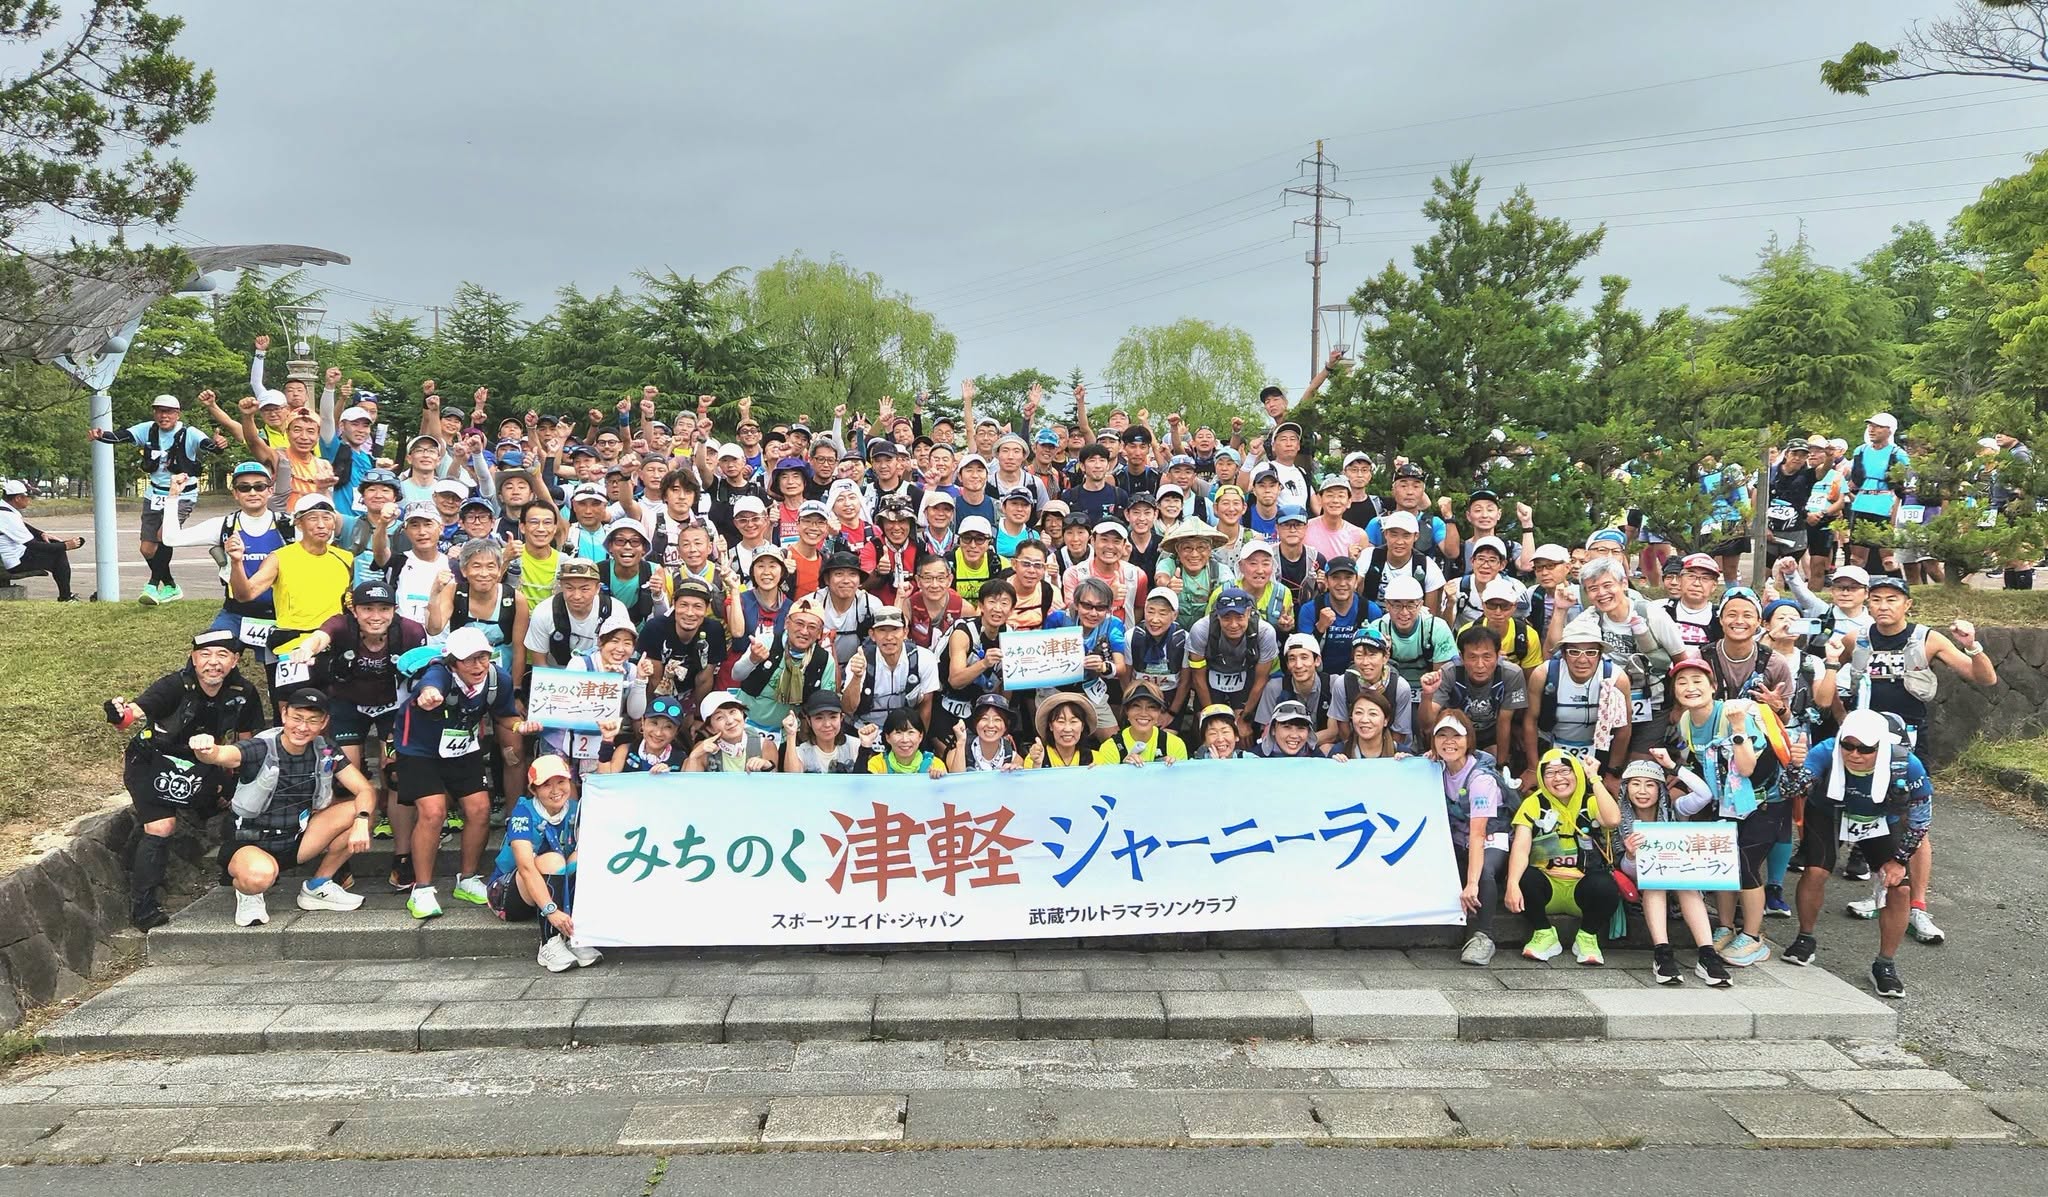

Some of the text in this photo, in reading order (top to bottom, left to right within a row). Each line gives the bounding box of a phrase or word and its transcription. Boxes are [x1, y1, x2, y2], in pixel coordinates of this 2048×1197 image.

[1004, 637, 1081, 657] みちのく津軽
[1003, 659, 1081, 679] ジャーニーラン
[534, 680, 621, 700] みちのく津軽
[530, 696, 617, 719] ジャーニーラン
[576, 736, 585, 752] 2
[1638, 834, 1734, 855] みちのく津軽
[1637, 855, 1735, 876] ジャーニーラン
[770, 895, 1239, 930] スポーツエイド・ジャパン 武蔵ウルトラマラソンクラブ
